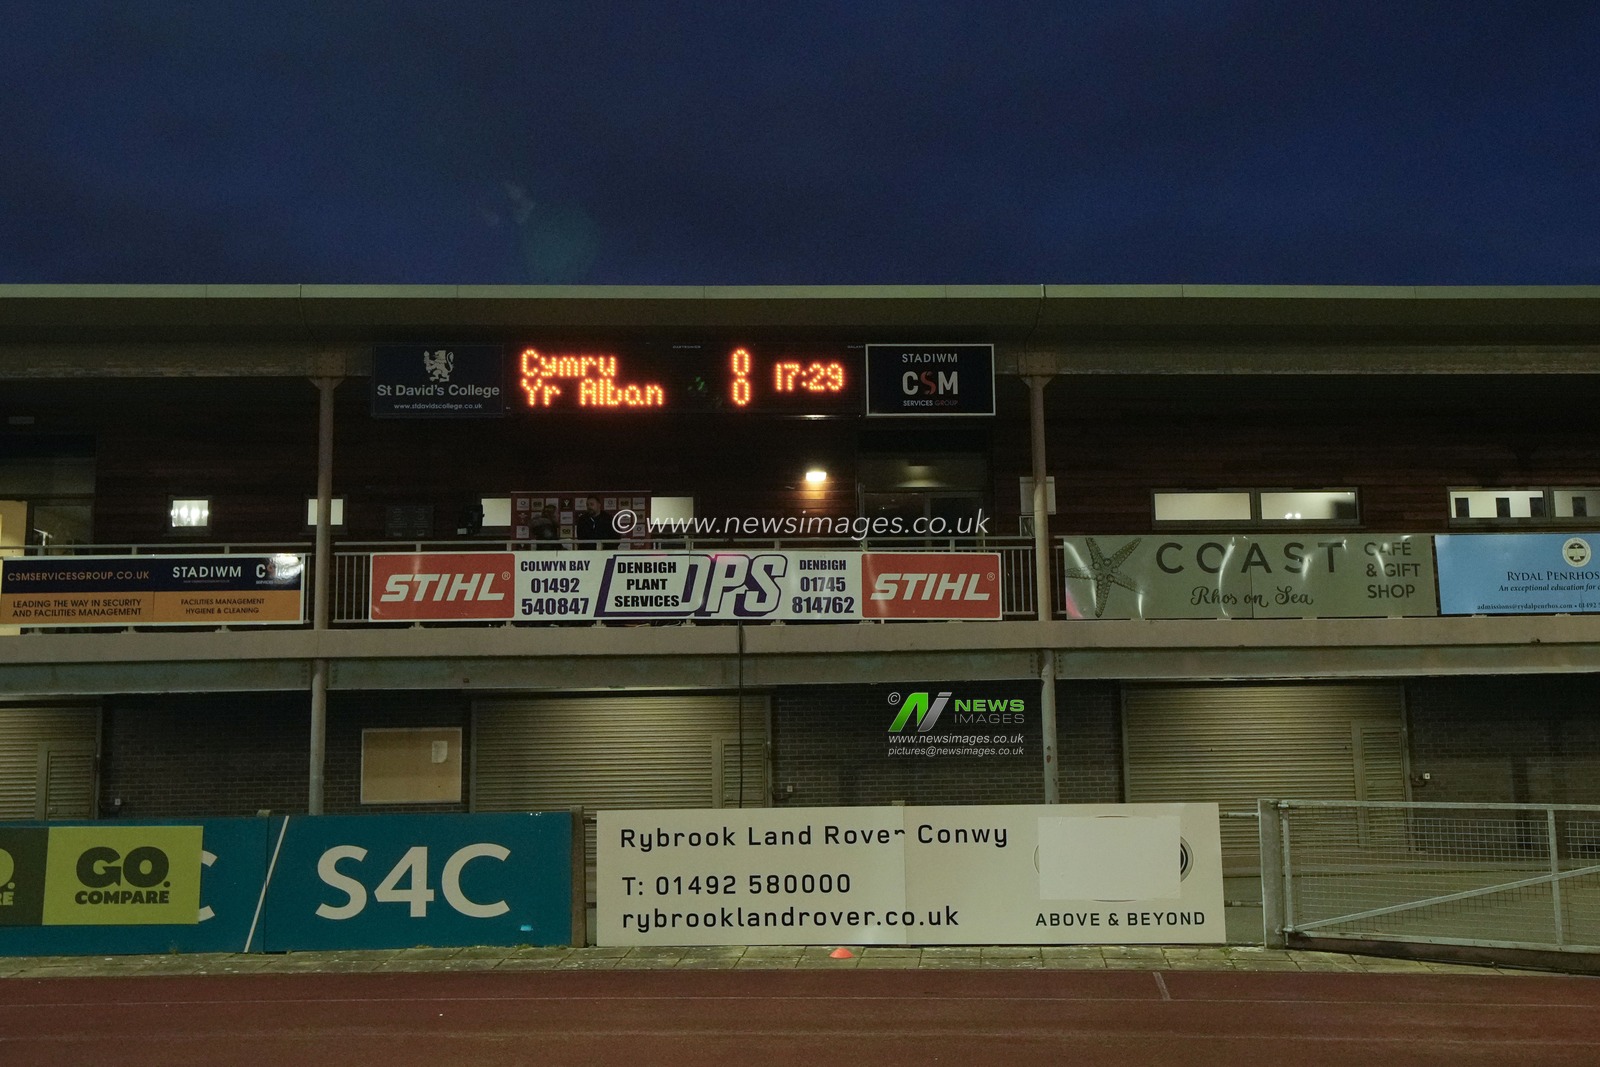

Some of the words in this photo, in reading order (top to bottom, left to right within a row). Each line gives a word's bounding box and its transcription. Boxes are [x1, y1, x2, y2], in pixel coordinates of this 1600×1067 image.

[521, 348, 617, 377] Cymru
[732, 348, 750, 376] 0
[902, 353, 959, 364] STADIWM
[775, 362, 844, 392] 17:29
[902, 370, 960, 396] CSM
[376, 384, 393, 396] St
[395, 384, 445, 397] David's
[448, 384, 500, 400] College
[520, 377, 561, 406] Yr
[579, 377, 664, 406] Alban
[732, 377, 750, 406] 0
[393, 402, 483, 410] www.stdavidscollege.co.uk
[799, 559, 847, 571] DENBIGH
[1155, 541, 1344, 574] COAST
[172, 566, 242, 579] STADIWM
[520, 560, 567, 571] COLWYN
[569, 560, 591, 571] BAY
[617, 561, 677, 574] DENBIGH
[1366, 564, 1377, 577] &
[1384, 563, 1421, 577] GIFT
[7, 570, 150, 582] CSMSERVICESGROUP.CO.UK
[1507, 571, 1544, 581] RYDAL
[1546, 570, 1600, 581] PENRHOS
[380, 573, 505, 602] STIHL
[530, 577, 580, 594] 01492
[626, 578, 668, 591] PLANT
[800, 576, 846, 592] 01745
[870, 573, 991, 600] STIHL
[1367, 584, 1416, 599] SHOP
[1498, 584, 1508, 592] An
[1510, 583, 1550, 593] exceptional
[1550, 583, 1585, 591] education
[1584, 582, 1596, 593] for
[13, 600, 51, 609] LEADING
[70, 599, 88, 607] WAY
[91, 599, 100, 607] IN
[102, 598, 142, 607] SECURITY
[181, 598, 214, 606] FACILITIES
[215, 598, 265, 606] MANAGEMENT
[614, 594, 680, 607] SERVICES
[1190, 585, 1237, 606] Rhos
[1243, 593, 1269, 608] on
[1274, 585, 1314, 606] Sea
[12, 609, 32, 618] AND
[34, 609, 76, 617] FACILITIES
[78, 607, 142, 616] MANAGEMENT
[185, 607, 215, 615] HYGIENE
[223, 606, 260, 614] CLEANING
[521, 597, 589, 616] 540847
[791, 596, 855, 614] 814762
[1477, 602, 1573, 611] admissions@rydalpenrhos.com
[621, 827, 736, 852] Rybrook
[749, 825, 812, 846] Land
[917, 824, 1008, 847] Conwy
[315, 843, 511, 920] S4C
[622, 876, 644, 895] T:
[656, 875, 736, 895] 01492
[749, 873, 850, 894] 580000
[75, 890, 169, 905] COMPARE
[623, 906, 959, 932] rybrooklandrover.co.uk
[1036, 912, 1100, 926] ABOVE
[1108, 912, 1119, 926] &
[1128, 911, 1205, 926] BEYOND
